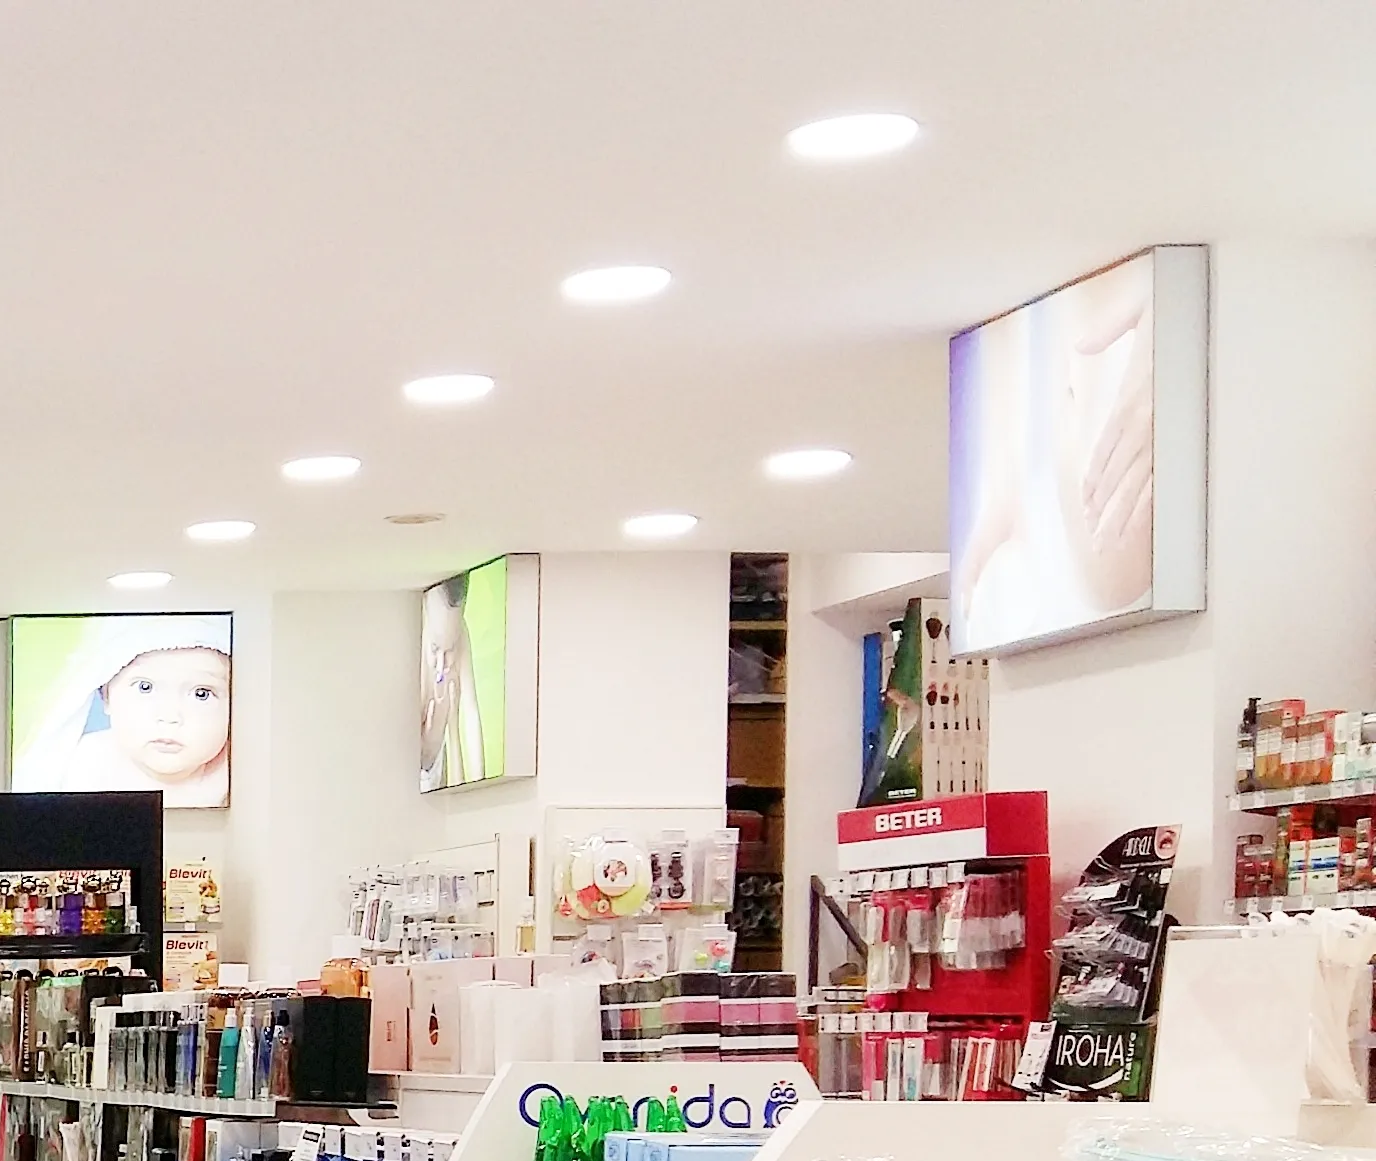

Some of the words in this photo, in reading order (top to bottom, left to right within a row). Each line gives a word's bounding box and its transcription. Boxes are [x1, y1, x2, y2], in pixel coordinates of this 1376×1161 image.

[887, 788, 917, 797] BETER
[875, 807, 942, 833] BETER
[169, 868, 207, 879] Blevit
[165, 940, 204, 950] Blevit
[1055, 1033, 1125, 1068] IROHA
[1123, 1031, 1137, 1081] nature
